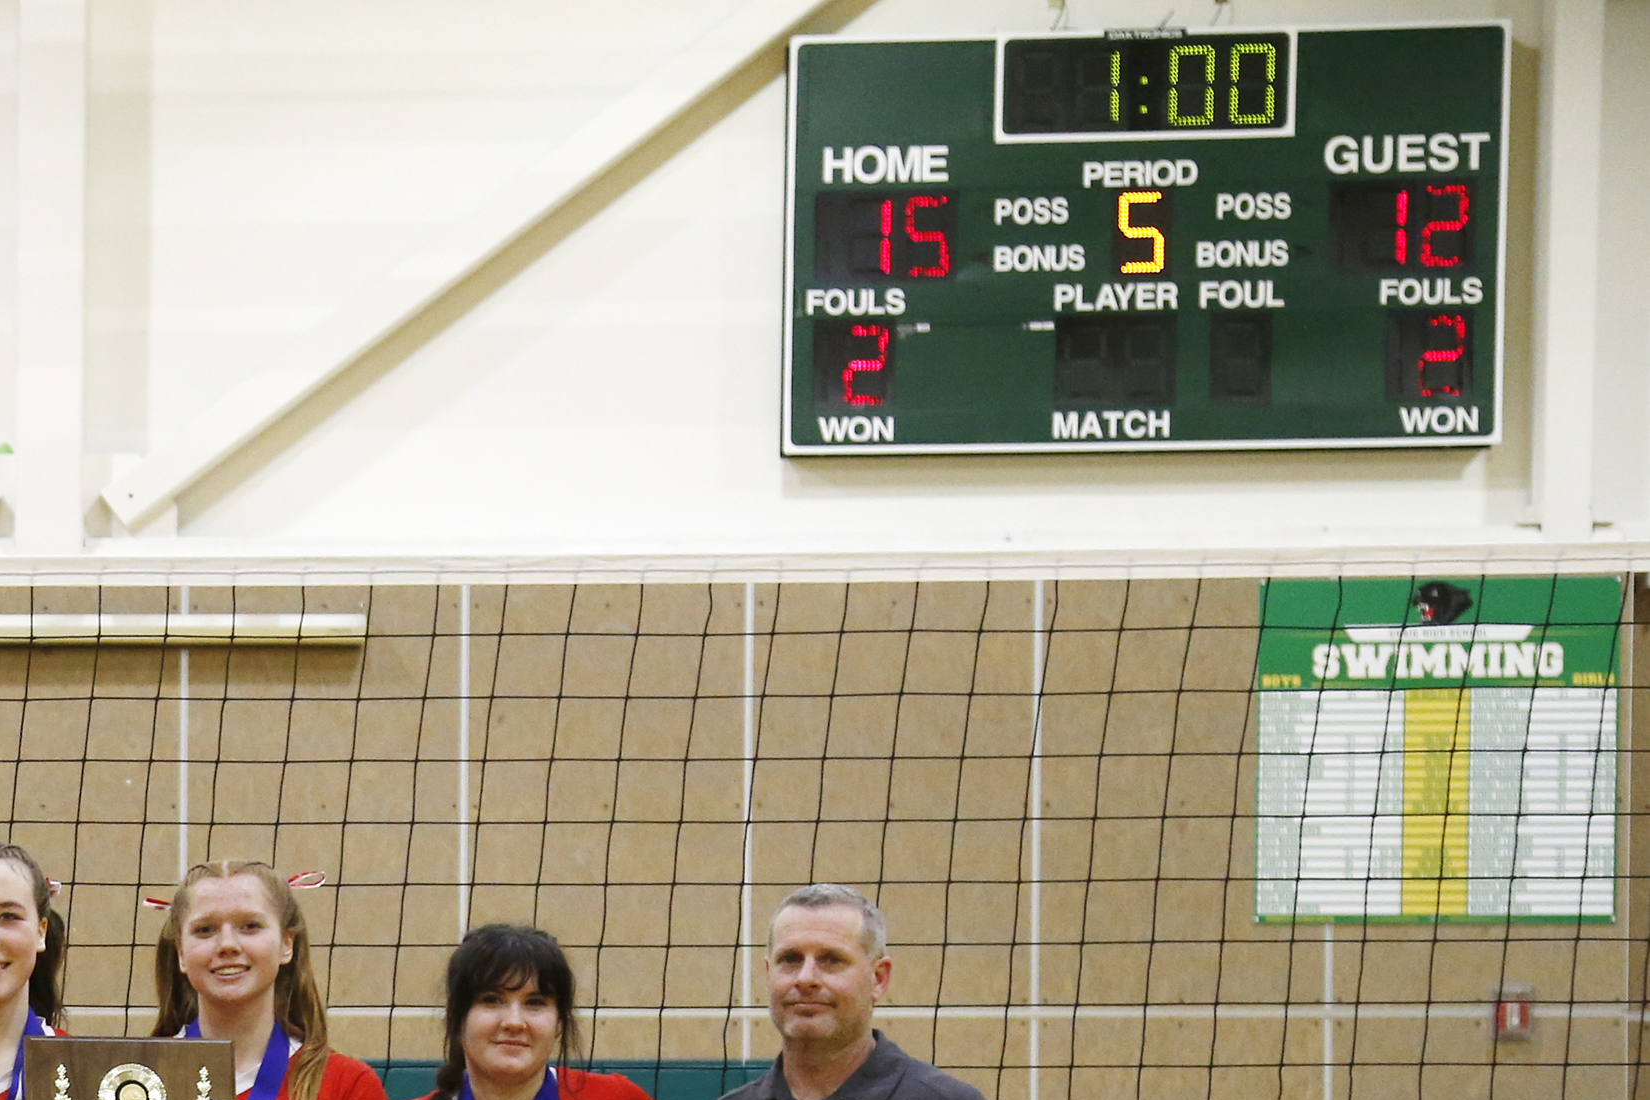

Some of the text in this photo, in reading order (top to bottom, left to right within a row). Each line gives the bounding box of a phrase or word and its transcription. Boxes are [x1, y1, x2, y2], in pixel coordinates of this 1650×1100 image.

[1109, 42, 1278, 127] 1:00
[821, 145, 950, 184] HOME
[1323, 131, 1492, 175] GUEST
[1081, 159, 1199, 189] PERIOD
[993, 197, 1070, 226] POSS
[1216, 192, 1293, 221] POSS
[880, 195, 950, 278] 15
[1117, 191, 1165, 275] 5
[1395, 184, 1470, 267] 12
[992, 244, 1086, 273] BONUS
[1196, 239, 1290, 269] BONUS
[805, 287, 907, 317] FOULS
[1053, 279, 1285, 312] PLAYER FOUL
[1379, 276, 1484, 306] FOULS
[841, 325, 891, 406] 2
[817, 416, 896, 444] WON
[1052, 411, 1172, 440] MATCH
[1400, 406, 1481, 435] WON
[1311, 642, 1565, 679] SWIMMING
[1261, 674, 1302, 688] BOYS
[1572, 672, 1615, 687] GIRLS
